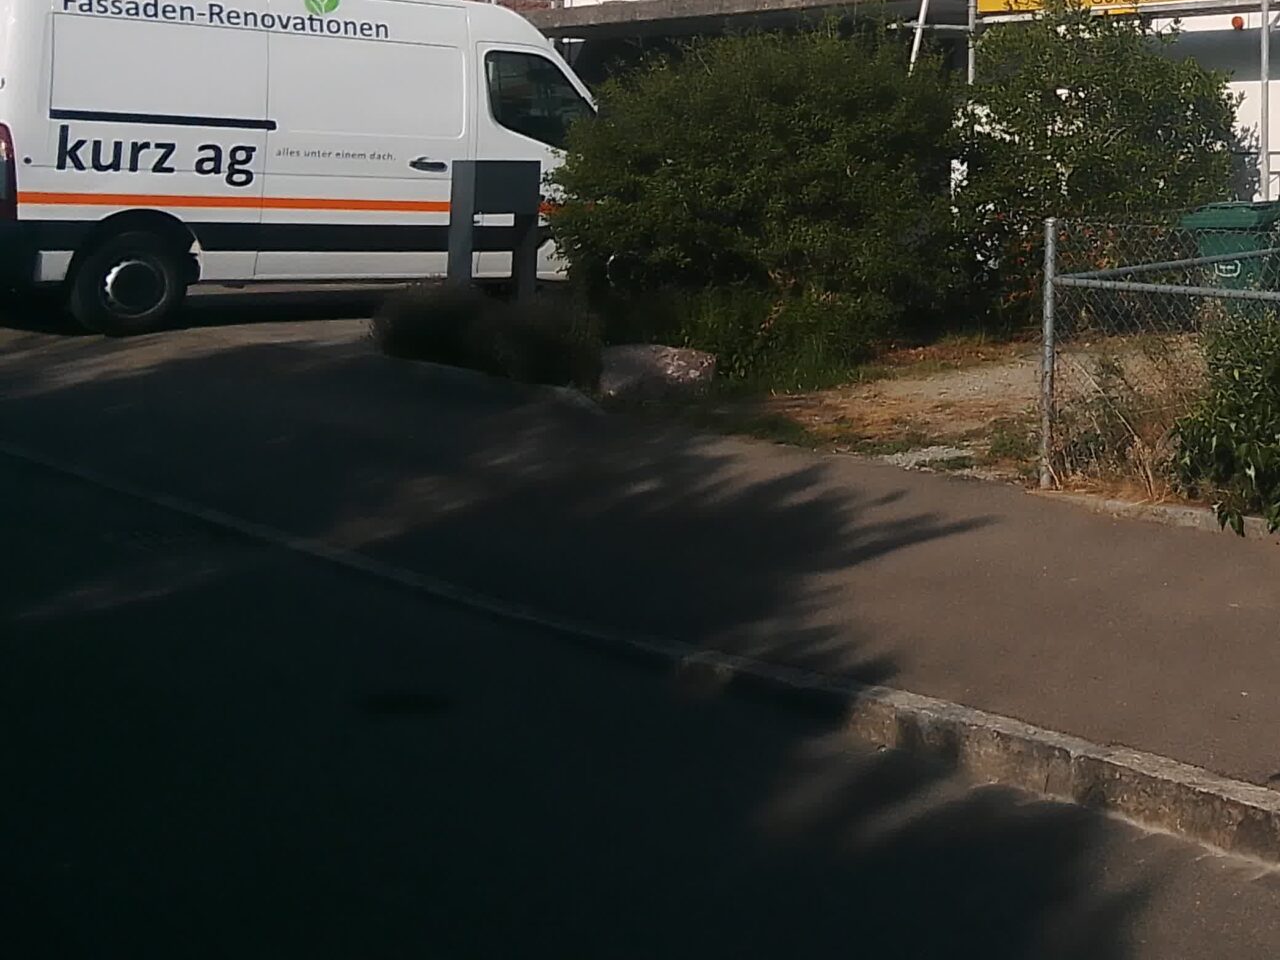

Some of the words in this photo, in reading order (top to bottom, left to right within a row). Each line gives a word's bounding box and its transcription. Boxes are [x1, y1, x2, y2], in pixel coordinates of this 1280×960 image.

[55, 123, 176, 174] kurz
[194, 142, 257, 187] ag
[276, 147, 300, 157] alles
[304, 149, 332, 158] unter
[335, 150, 367, 159] einem
